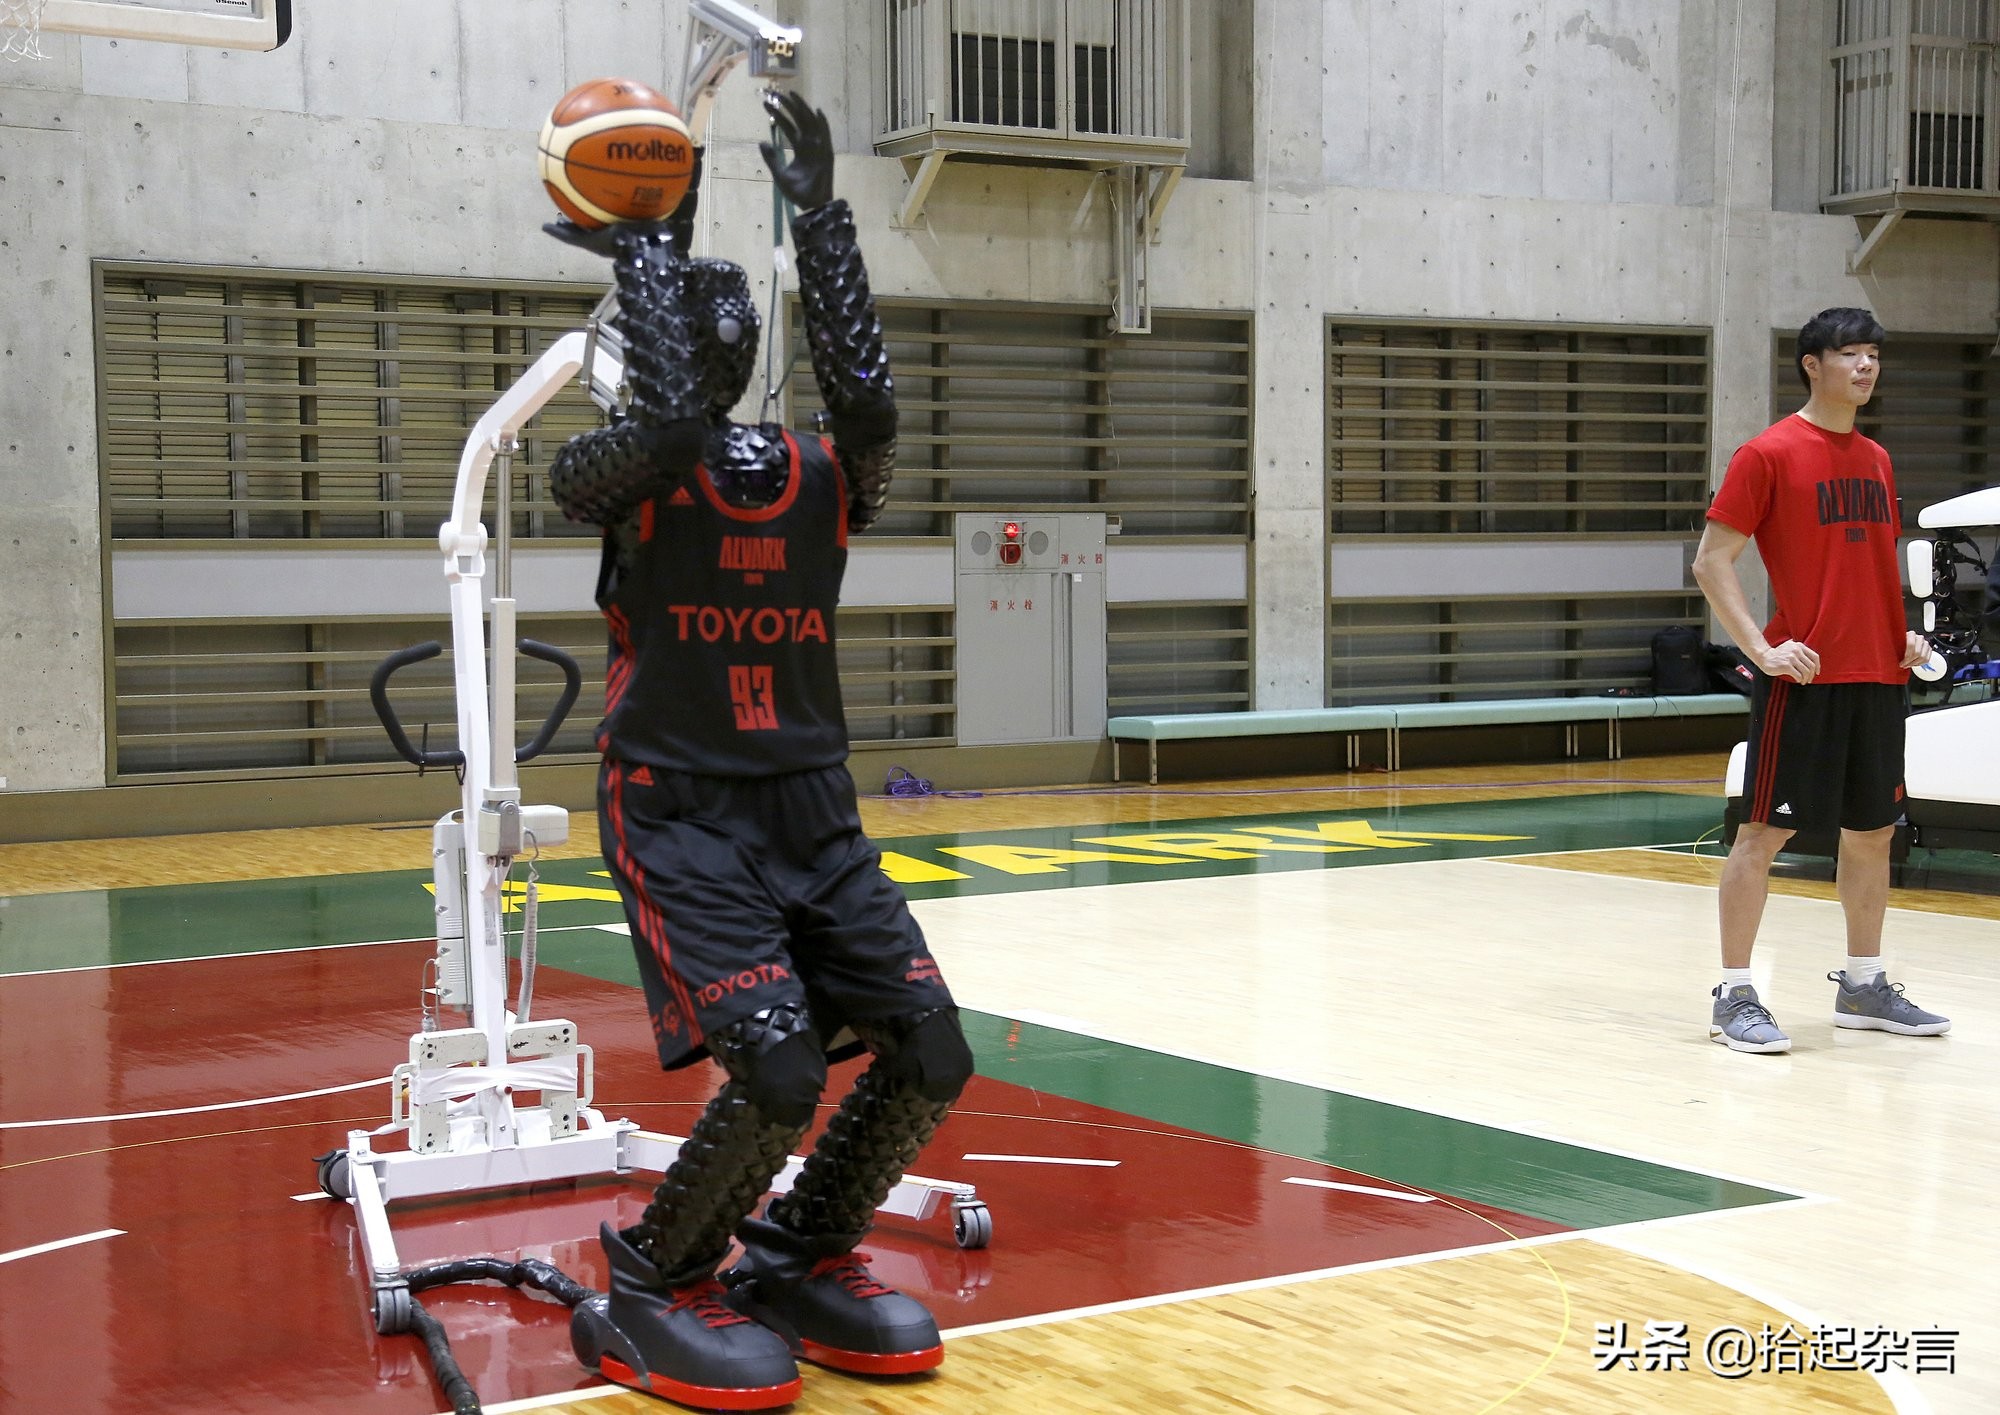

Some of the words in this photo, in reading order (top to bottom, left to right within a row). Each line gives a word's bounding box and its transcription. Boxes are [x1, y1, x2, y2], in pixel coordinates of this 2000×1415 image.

[607, 139, 686, 164] molten
[719, 536, 787, 571] ALVARK
[1060, 553, 1103, 565] 消火器
[989, 600, 1033, 611] 消火栓
[668, 605, 829, 643] TOYOTA
[728, 665, 780, 731] 93
[696, 964, 790, 1008] TOYOTA
